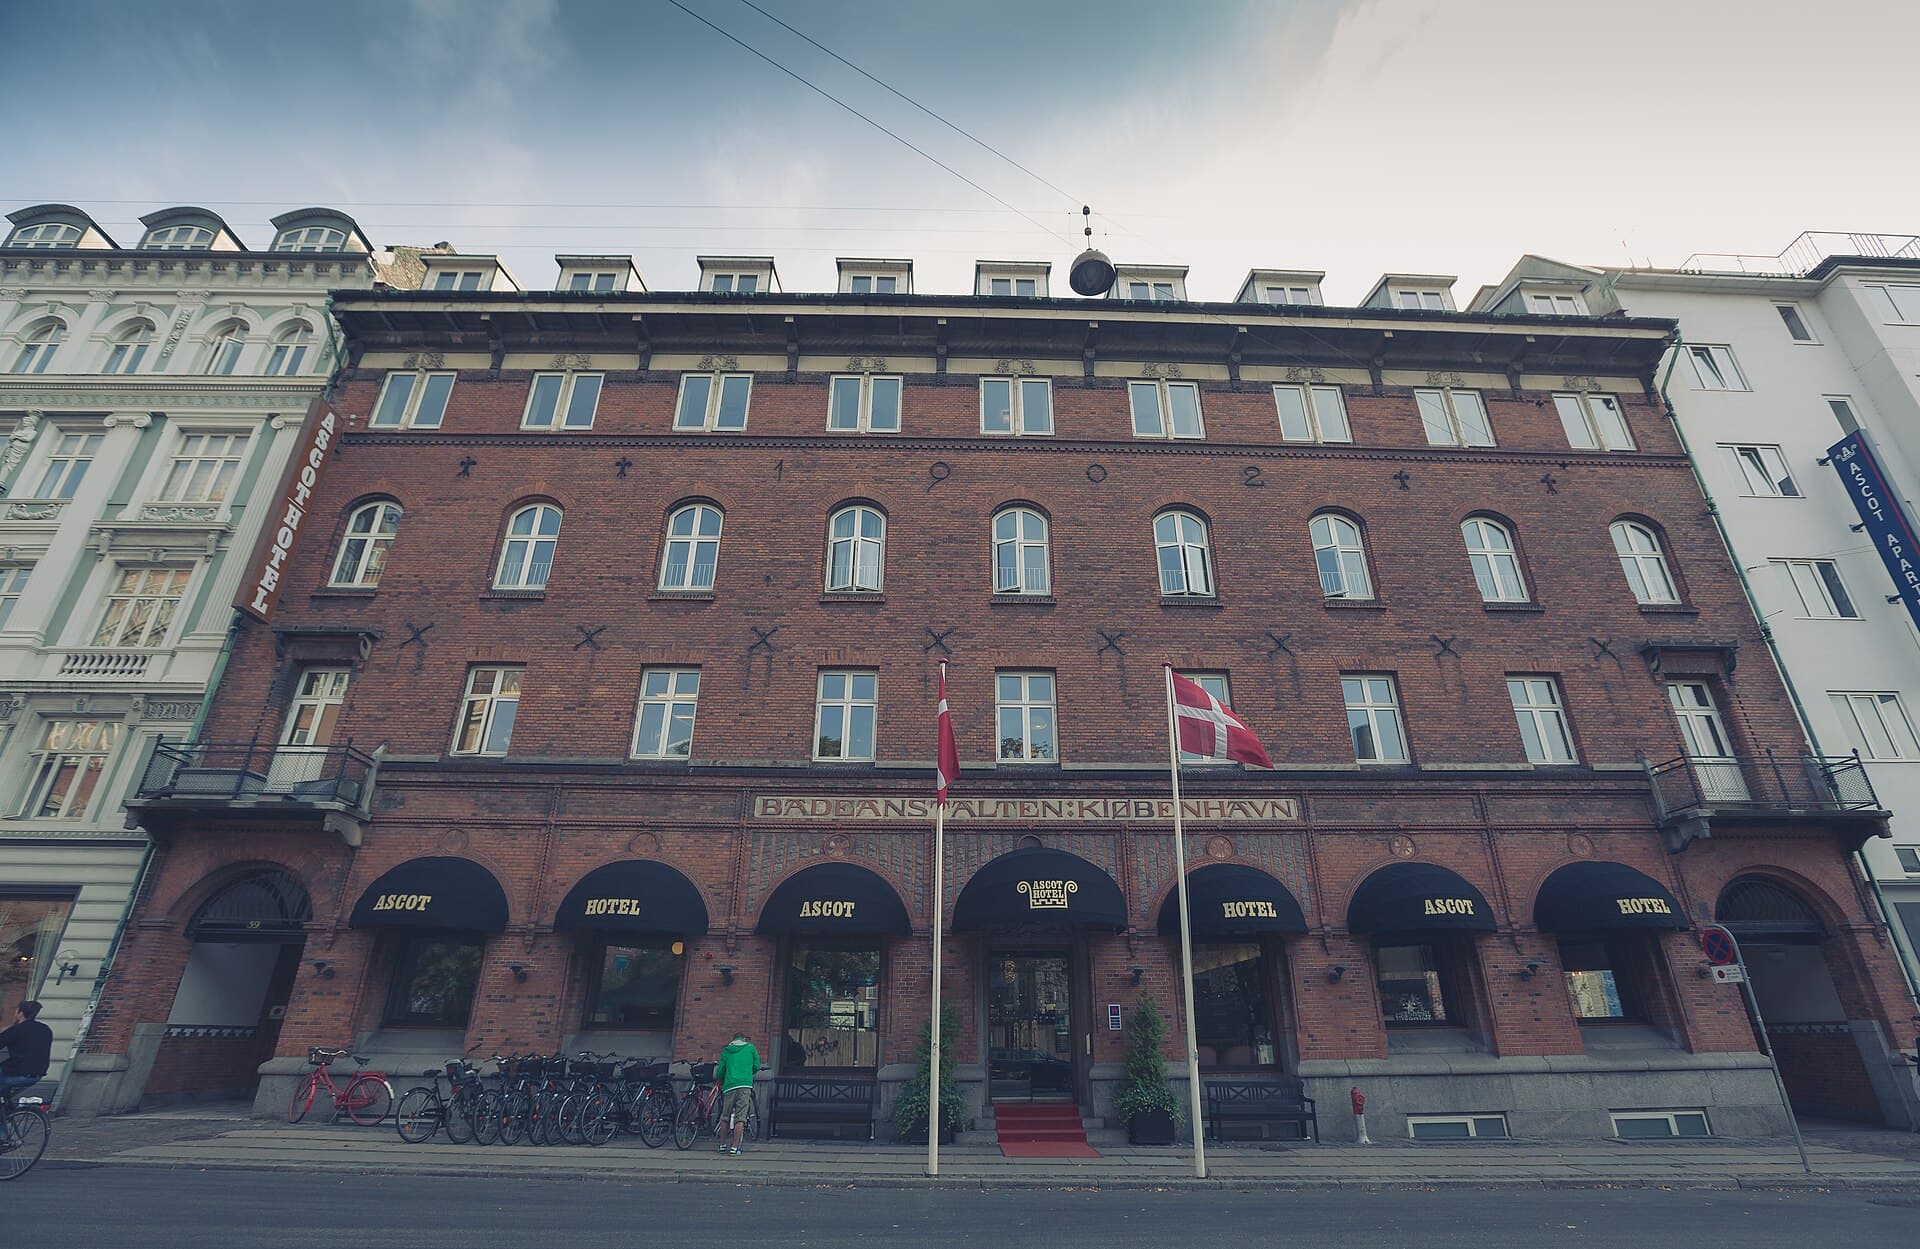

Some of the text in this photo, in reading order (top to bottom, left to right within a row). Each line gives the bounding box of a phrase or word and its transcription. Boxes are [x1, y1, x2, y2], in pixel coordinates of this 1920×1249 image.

[251, 411, 335, 615] ASCOT HOTEL
[1850, 462, 1920, 606] ASCOT APART
[1033, 880, 1063, 890] ASCOT
[373, 894, 431, 911] ASCOT
[1033, 889, 1064, 899] HOTEL
[585, 898, 641, 916] HOTEL
[800, 901, 855, 918] ASCOT
[1222, 901, 1277, 918] HOTEL
[1424, 898, 1473, 916] ASCOT
[1616, 898, 1671, 916] HOTEL
